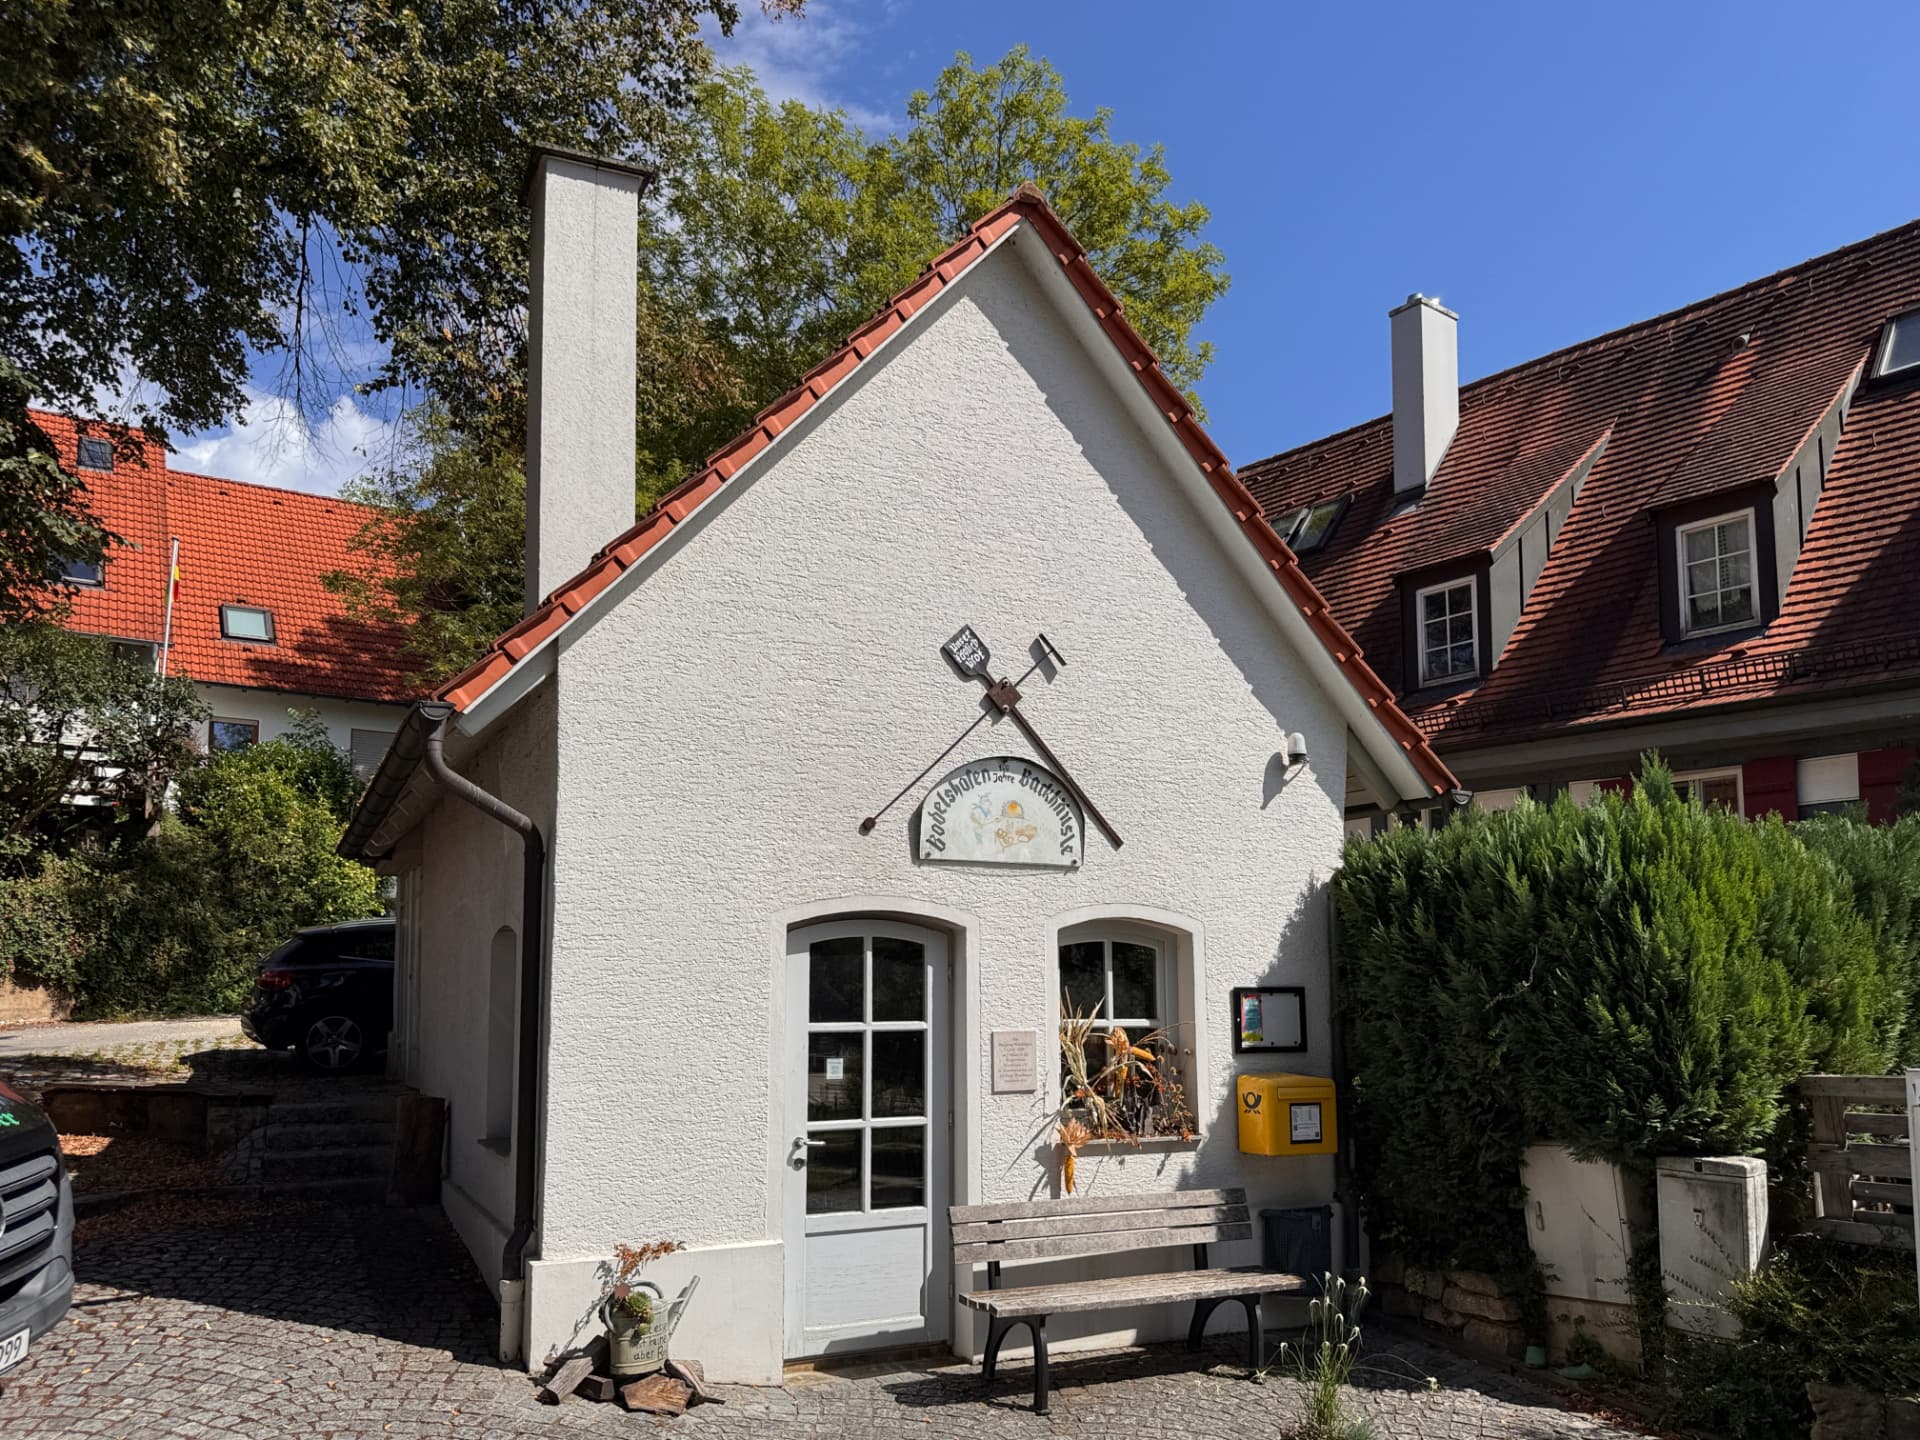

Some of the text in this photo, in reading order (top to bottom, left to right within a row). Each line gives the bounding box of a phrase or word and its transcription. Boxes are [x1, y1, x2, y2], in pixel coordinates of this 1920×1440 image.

[949, 628, 972, 653] Unser
[926, 767, 992, 853] Bodelshofen
[1018, 767, 1075, 856] Backhäusle
[633, 1350, 655, 1361] aber
